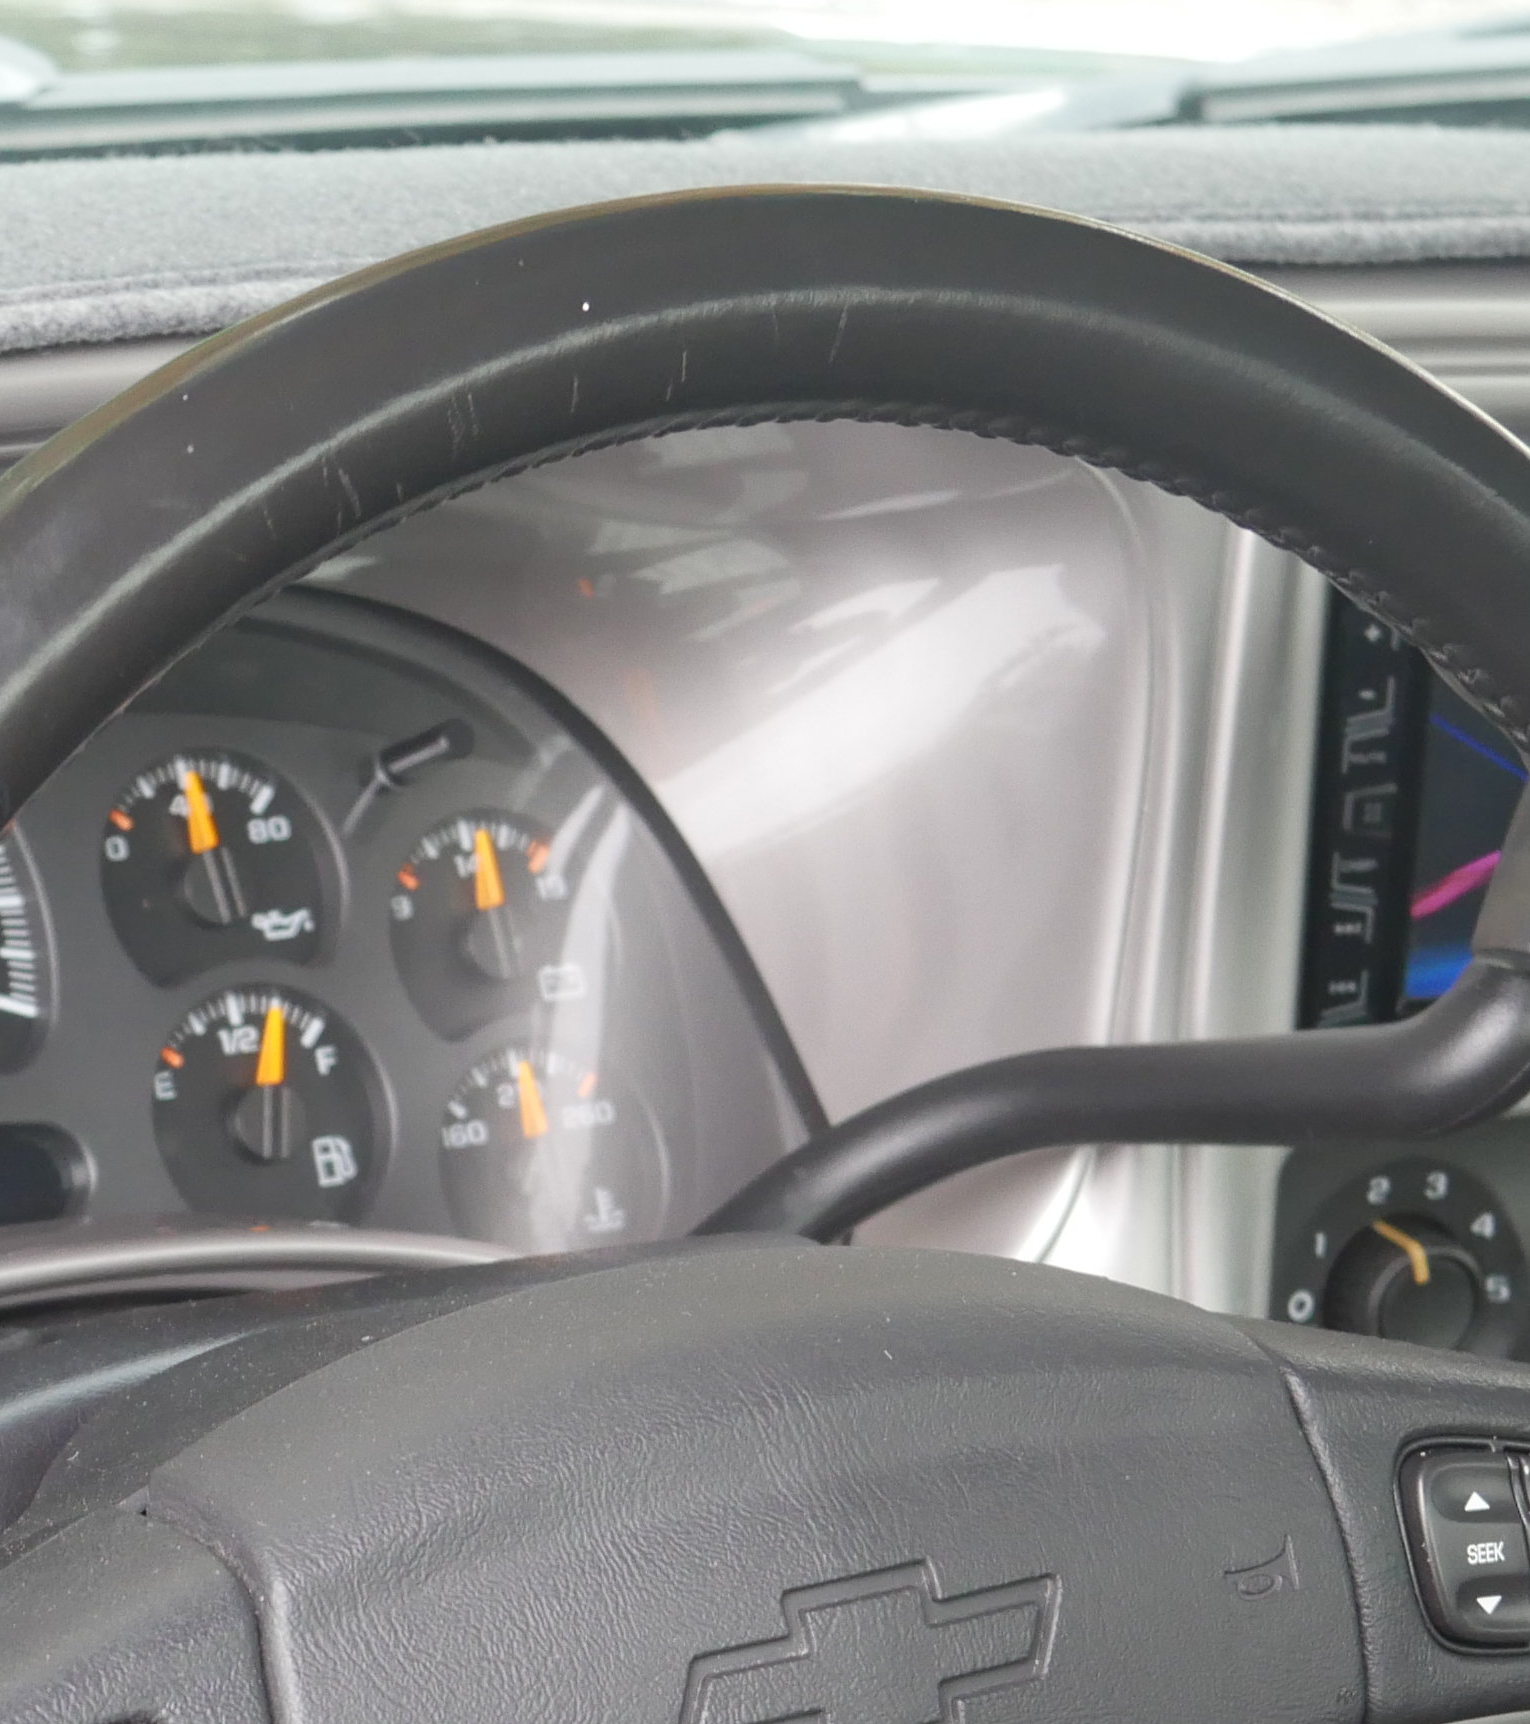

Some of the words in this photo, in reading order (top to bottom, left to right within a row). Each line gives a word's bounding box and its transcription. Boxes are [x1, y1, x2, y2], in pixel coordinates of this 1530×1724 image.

[247, 815, 292, 844] 80
[105, 835, 130, 862] 0
[218, 1024, 260, 1056] 1/2
[314, 1045, 336, 1076] F
[153, 1070, 177, 1101] E
[1367, 1175, 1391, 1205] 2
[1424, 1171, 1449, 1200] 3
[1471, 1212, 1496, 1239] 4
[1485, 1275, 1511, 1303] 5
[1287, 1289, 1315, 1323] 0
[1466, 1540, 1505, 1565] SEEK
